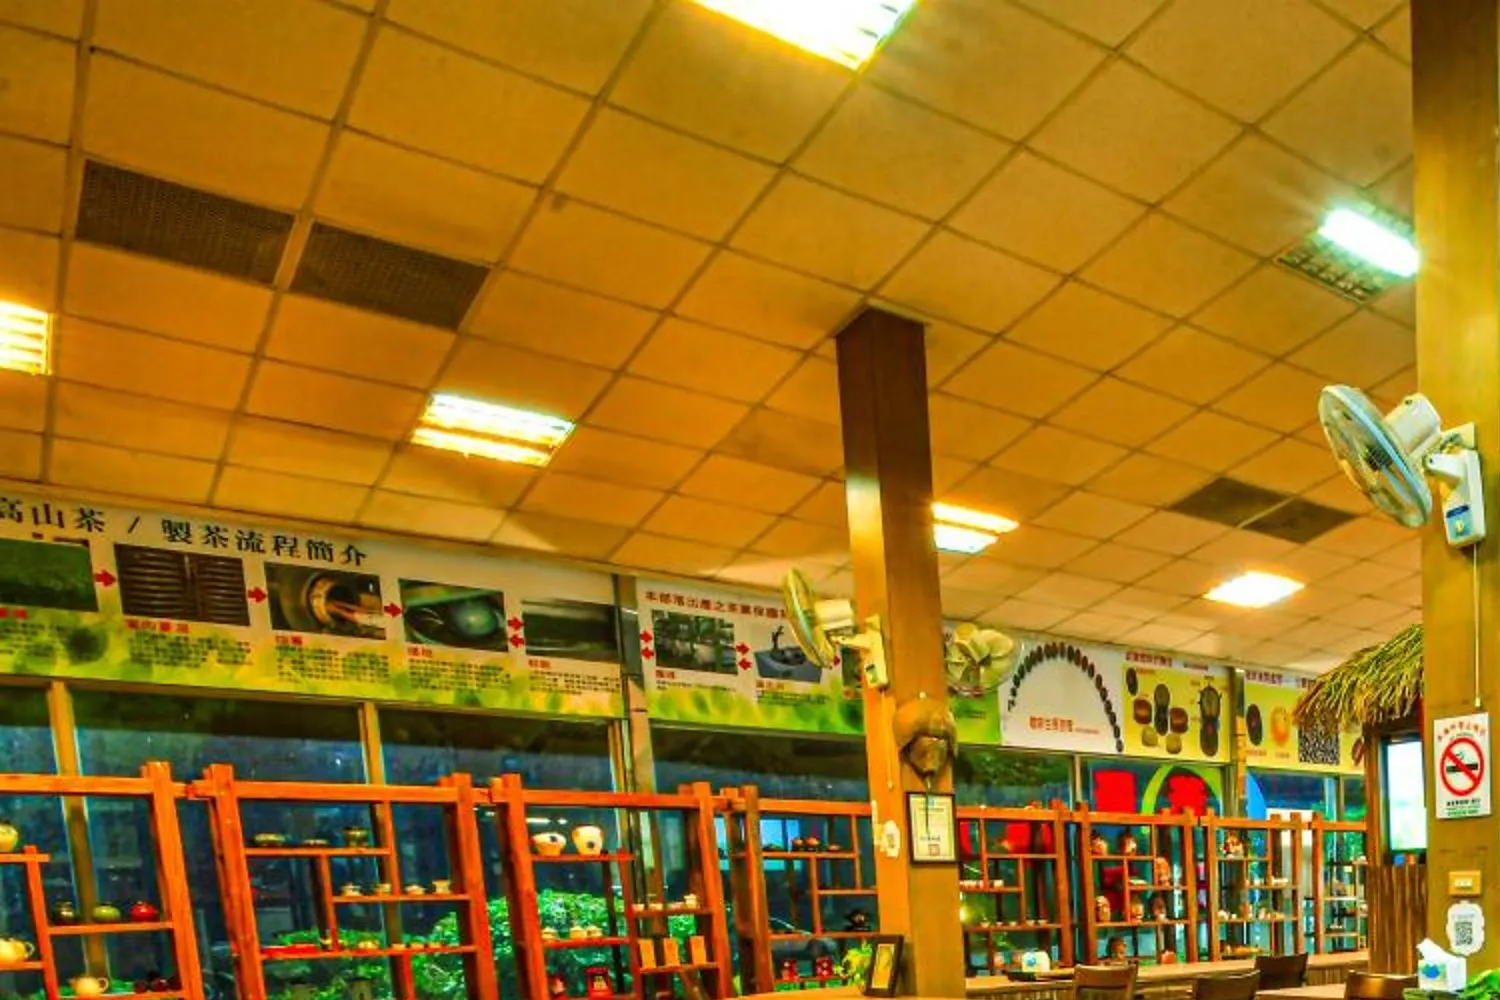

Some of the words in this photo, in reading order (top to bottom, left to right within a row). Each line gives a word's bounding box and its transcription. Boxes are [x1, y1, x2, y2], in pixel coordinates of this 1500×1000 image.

[161, 518, 368, 567] 製茶流程簡介
